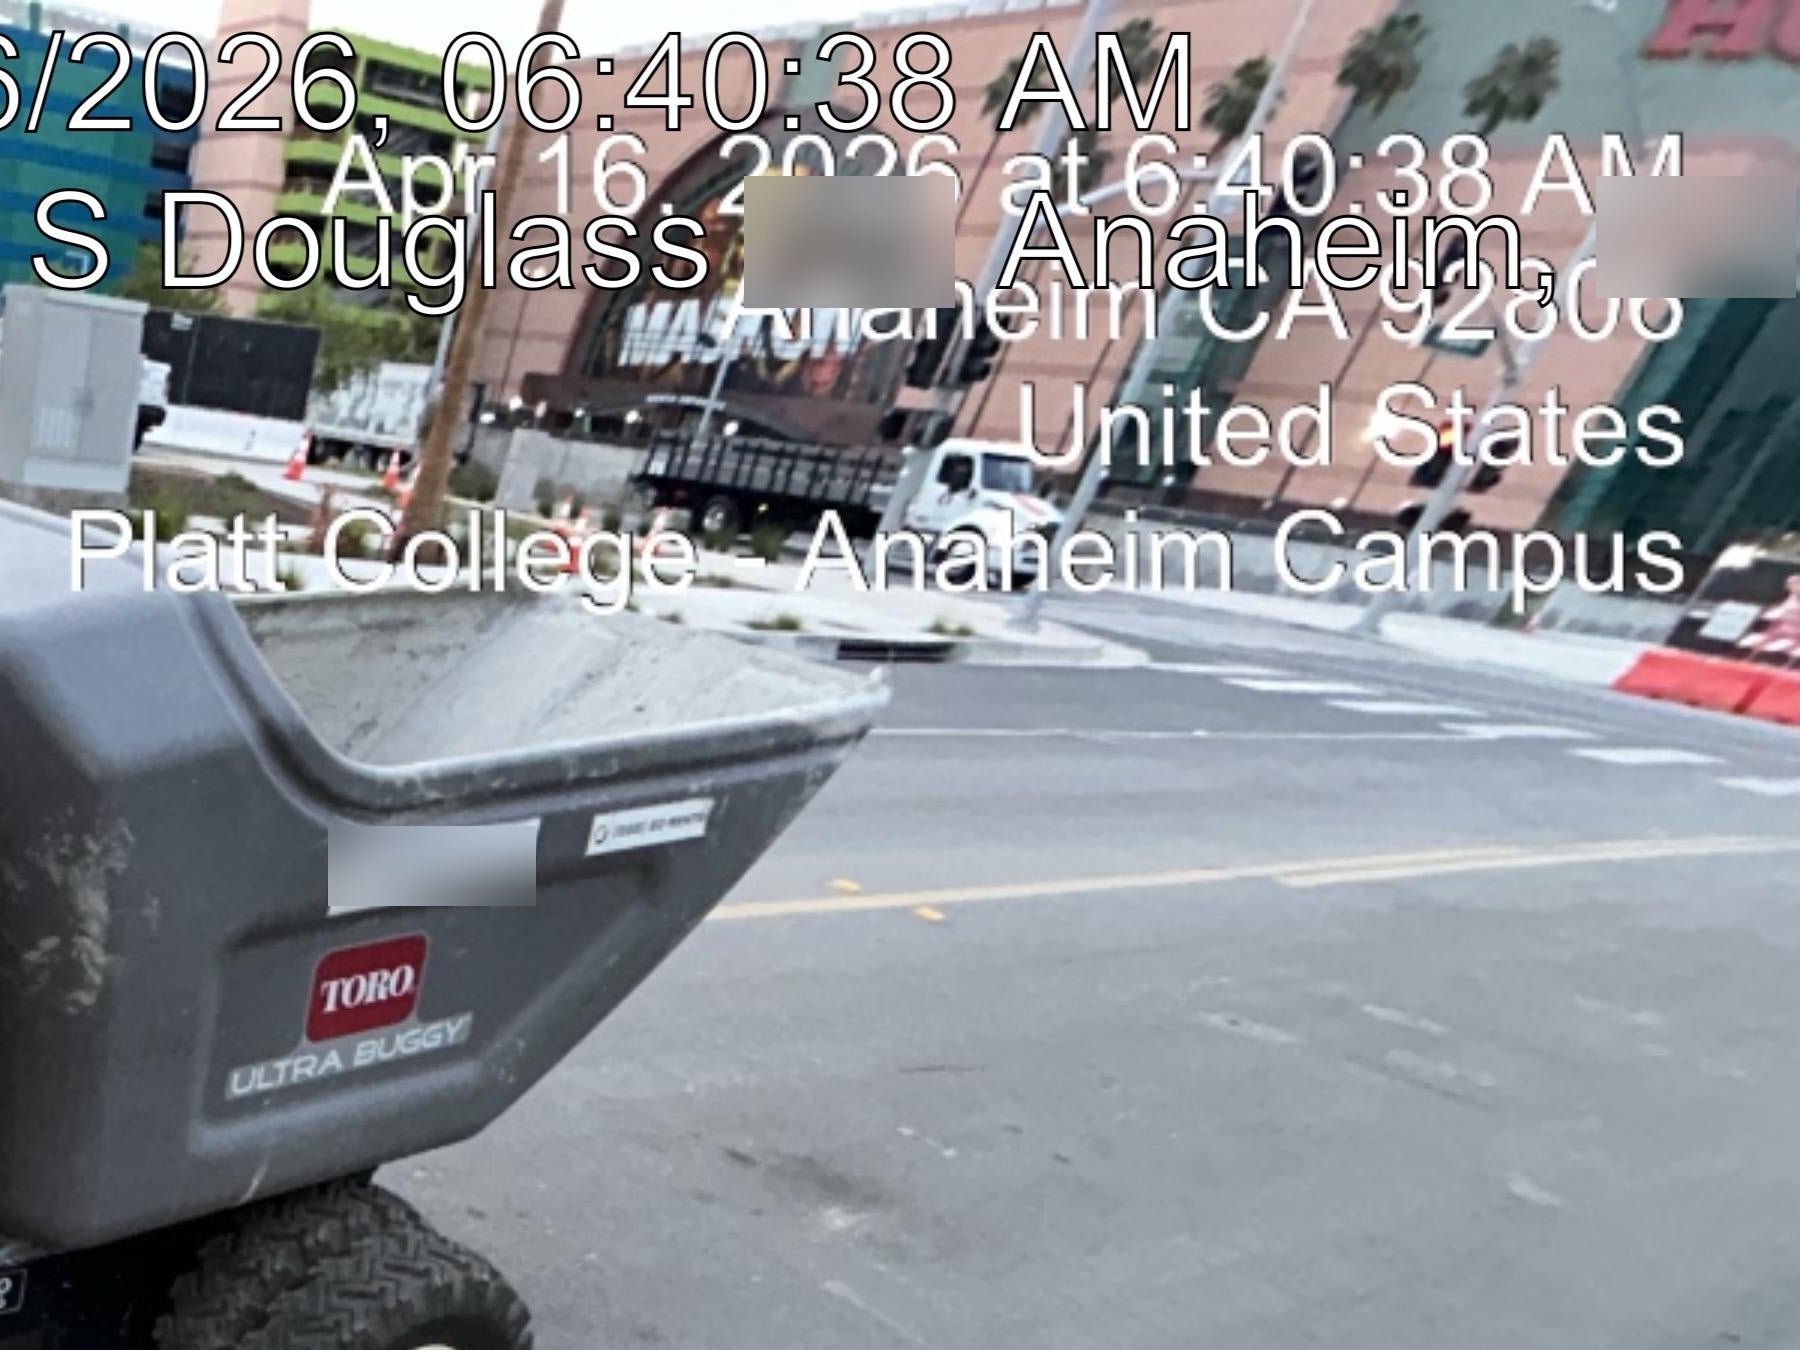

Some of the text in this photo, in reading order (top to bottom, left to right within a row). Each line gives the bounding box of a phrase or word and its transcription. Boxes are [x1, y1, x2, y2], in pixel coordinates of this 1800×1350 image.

[320, 963, 417, 1014] TORO
[229, 1017, 468, 1094] ULTRA BUGGY
